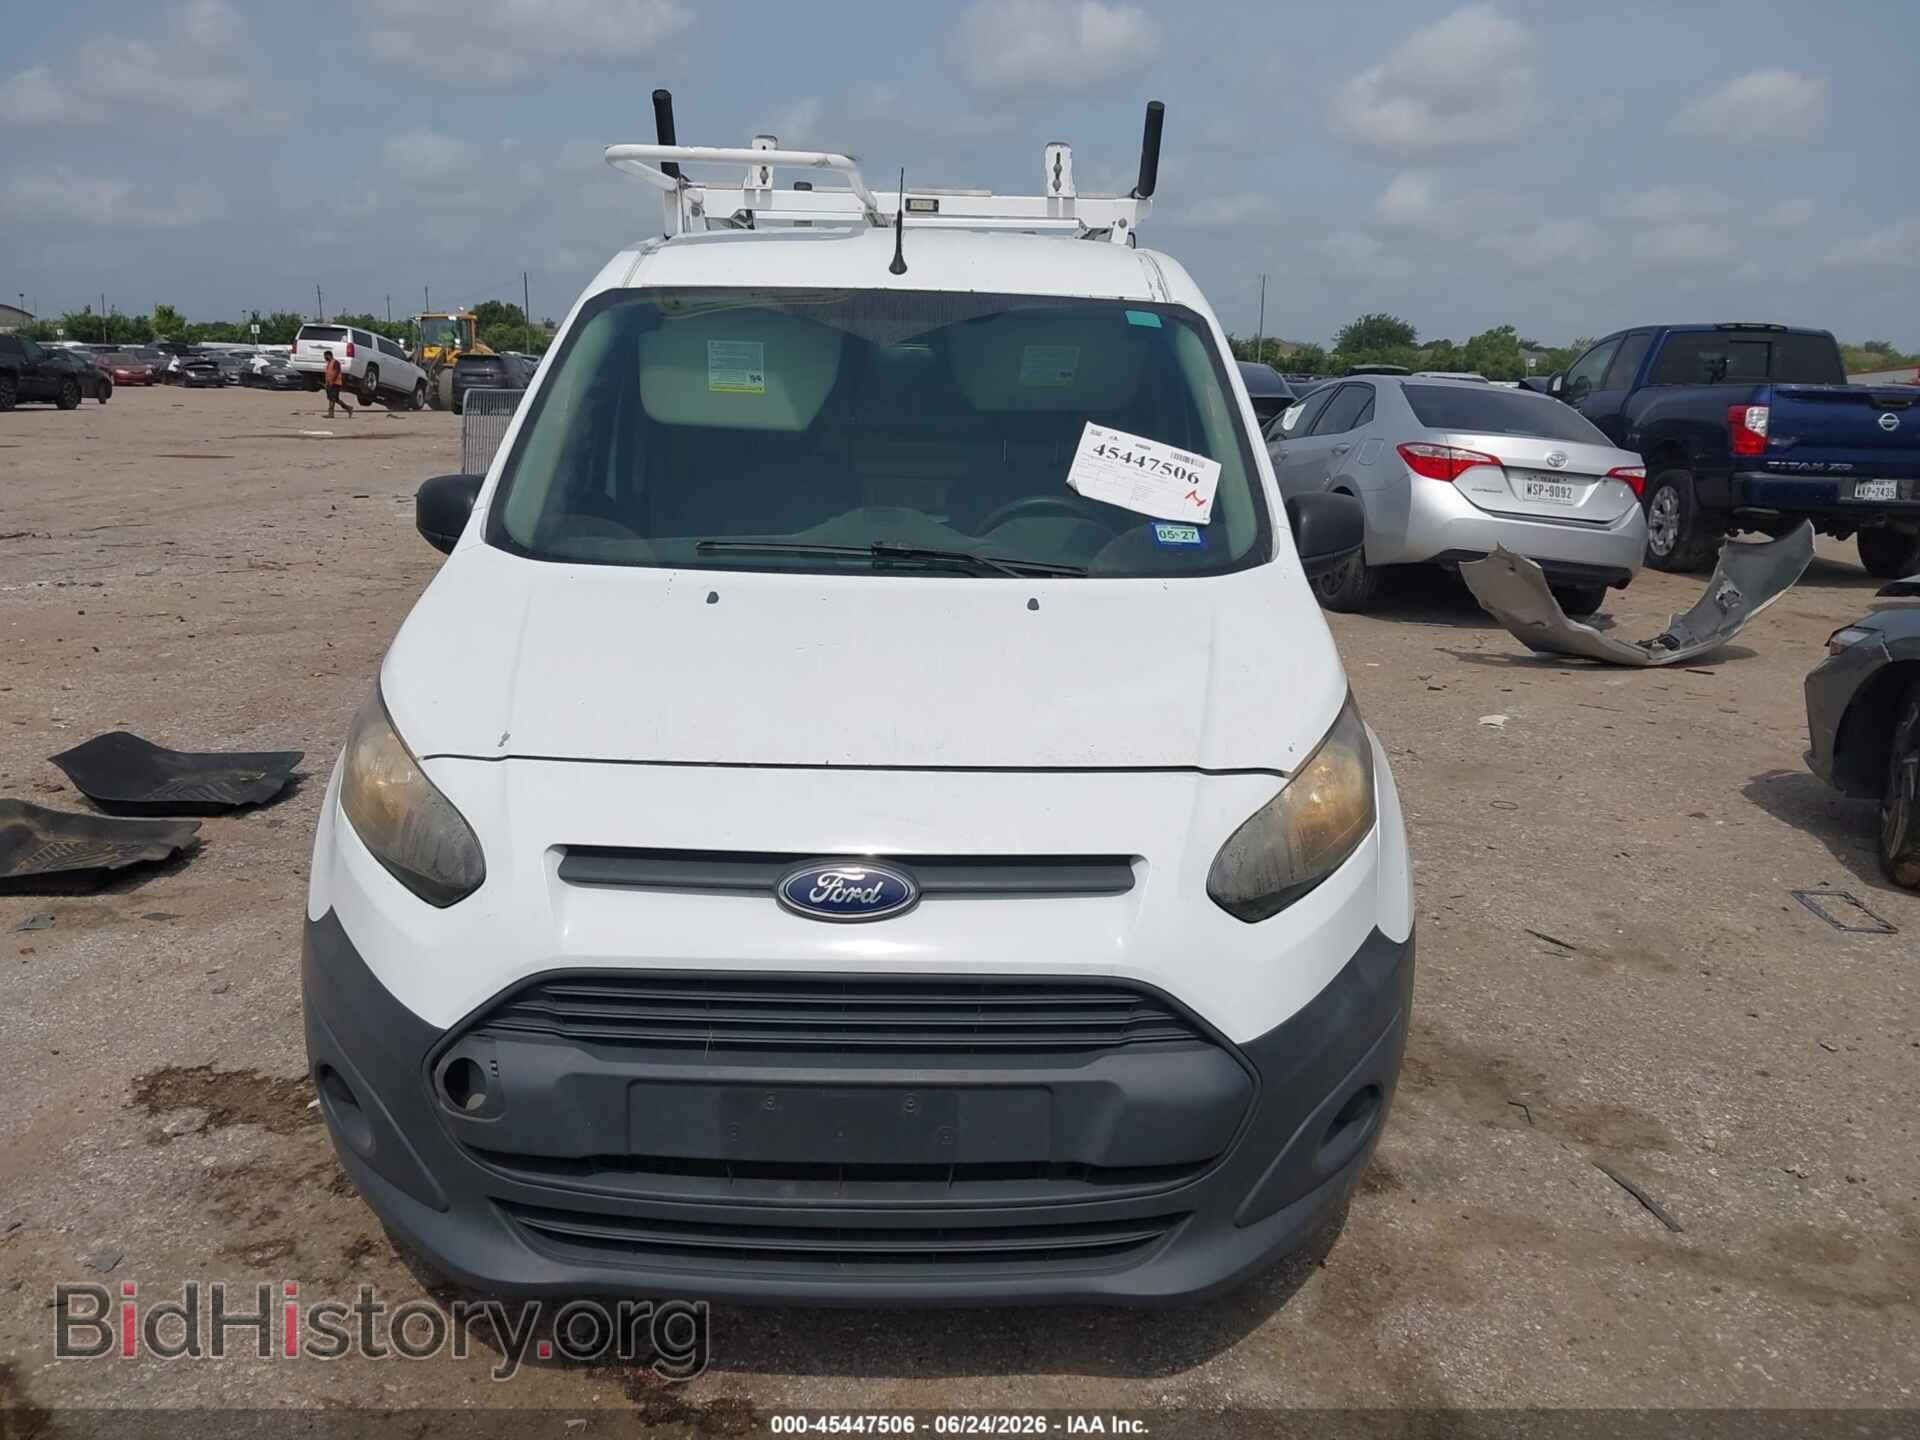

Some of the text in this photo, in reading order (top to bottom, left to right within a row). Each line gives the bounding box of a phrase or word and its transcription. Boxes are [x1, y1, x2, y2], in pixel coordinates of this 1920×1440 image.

[1092, 443, 1200, 485] 45447506
[1527, 483, 1573, 499] WSP-9092
[1159, 530, 1197, 541] 05 27
[808, 872, 884, 904] Ford
